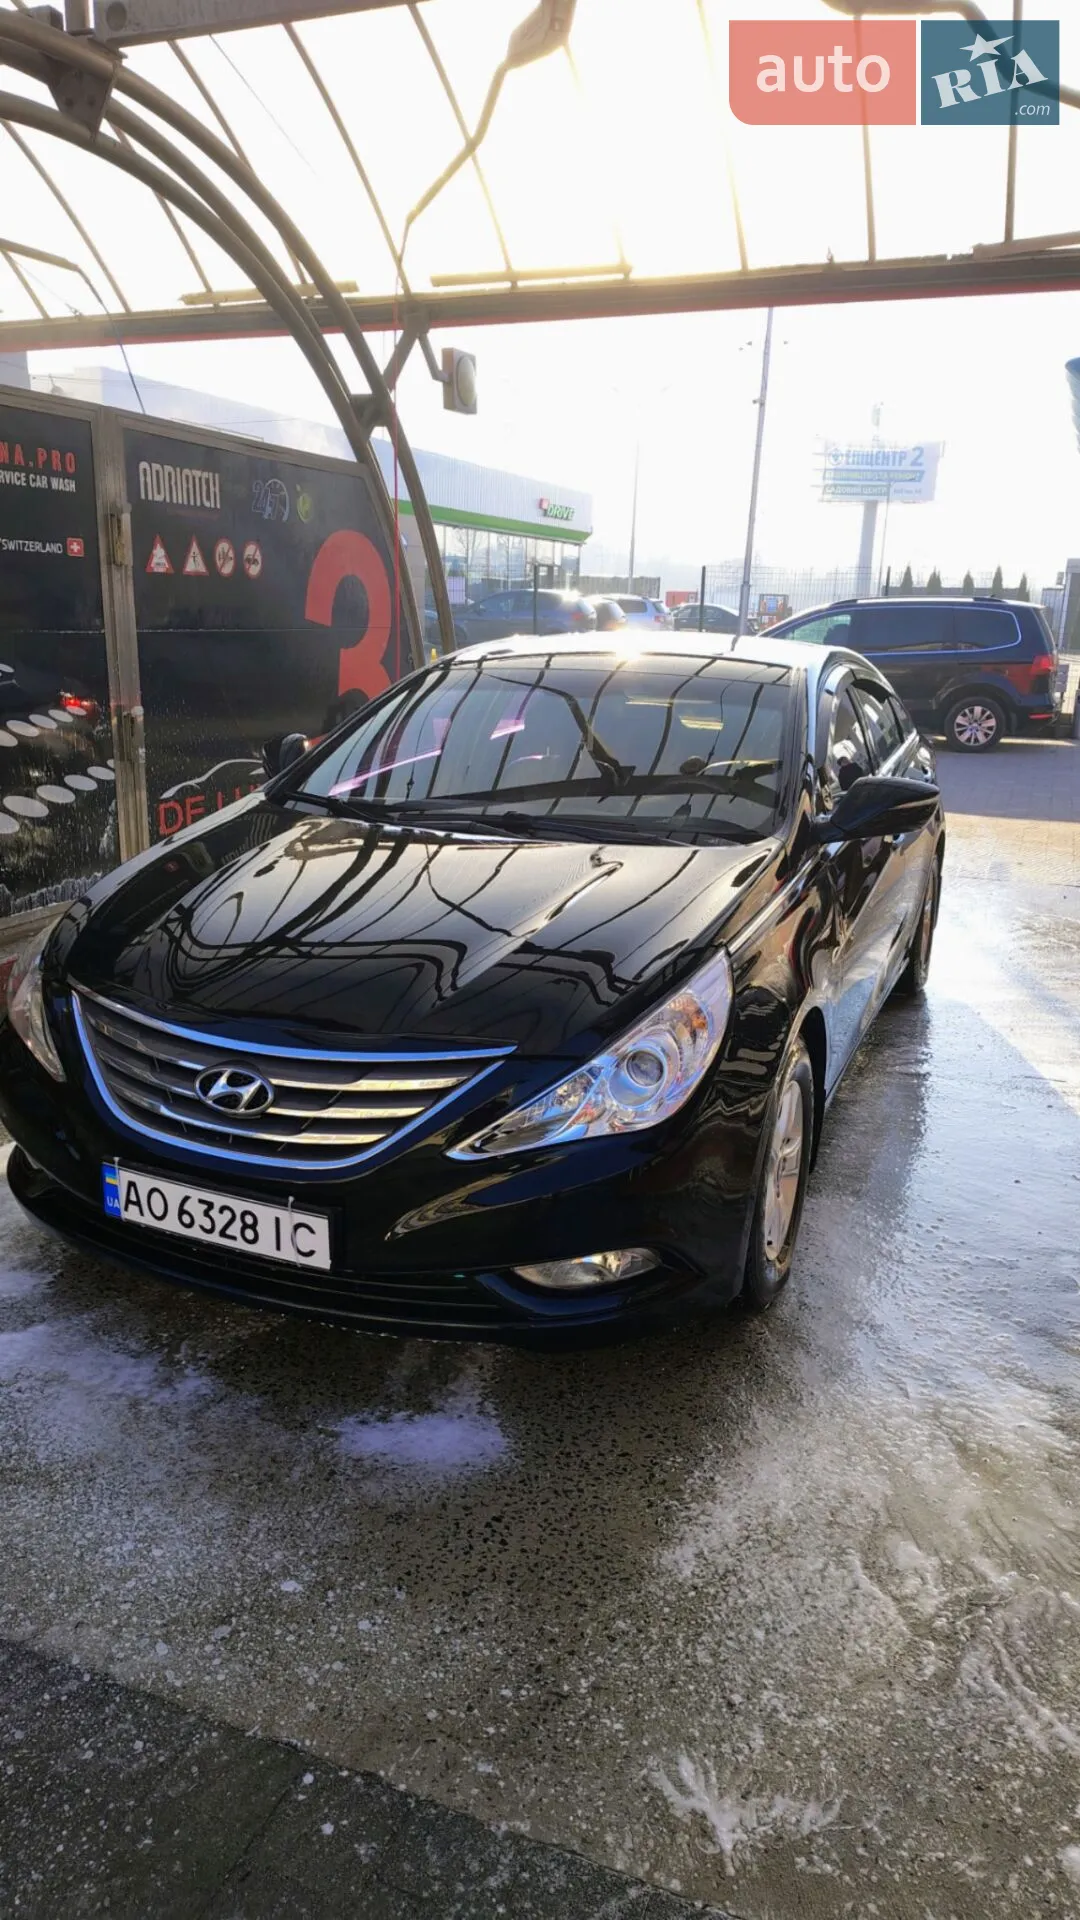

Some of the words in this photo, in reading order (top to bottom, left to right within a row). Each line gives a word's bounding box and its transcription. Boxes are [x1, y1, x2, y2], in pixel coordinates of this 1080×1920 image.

[910, 446, 925, 466] 2
[29, 473, 48, 489] CAR
[50, 476, 76, 492] WASH
[2, 539, 63, 553] SWITZERLAND
[106, 1196, 120, 1209] UA
[177, 1195, 260, 1245] 6328
